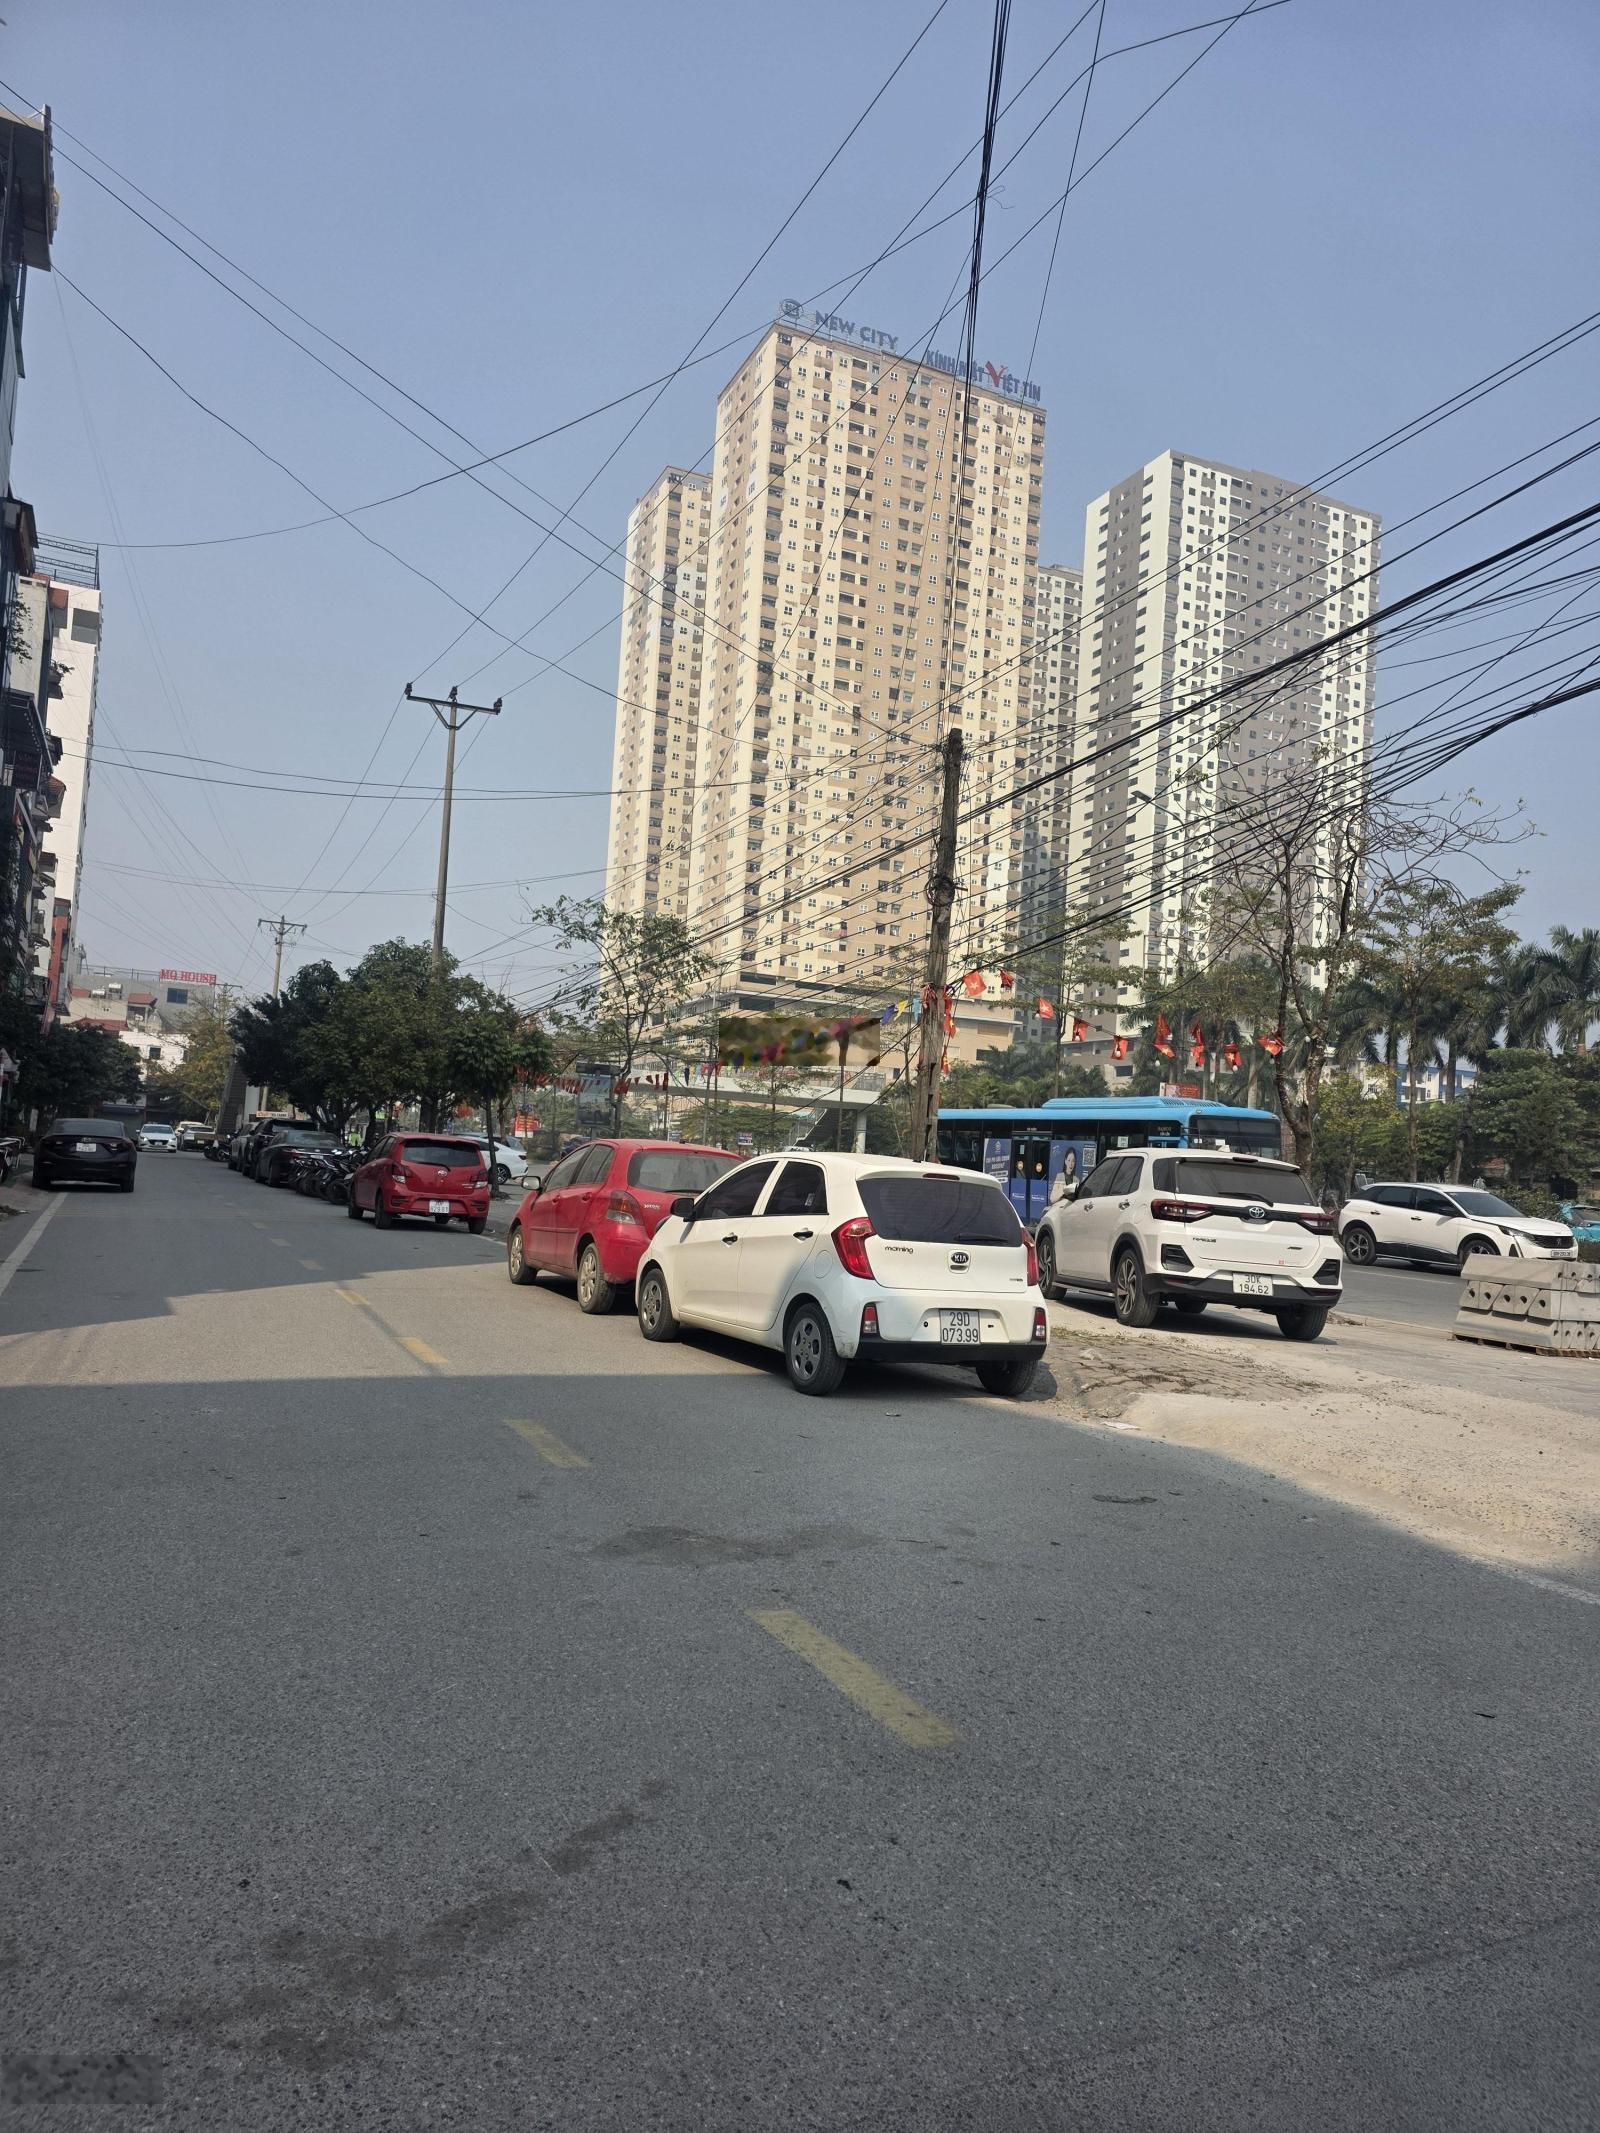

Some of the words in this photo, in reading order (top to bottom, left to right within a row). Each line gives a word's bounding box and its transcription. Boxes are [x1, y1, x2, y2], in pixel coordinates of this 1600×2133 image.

[815, 310, 855, 336] NEW
[860, 327, 899, 350] CITY
[926, 349, 955, 374] KÍNH
[1023, 380, 1041, 402] TÍN
[181, 971, 216, 985] HOUSE
[884, 1246, 914, 1255] morning
[954, 1254, 967, 1262] KIA
[1245, 1275, 1262, 1284] 30K
[1239, 1284, 1269, 1295] 194.62
[950, 1312, 970, 1327] 29D
[942, 1327, 979, 1342] 073.99
